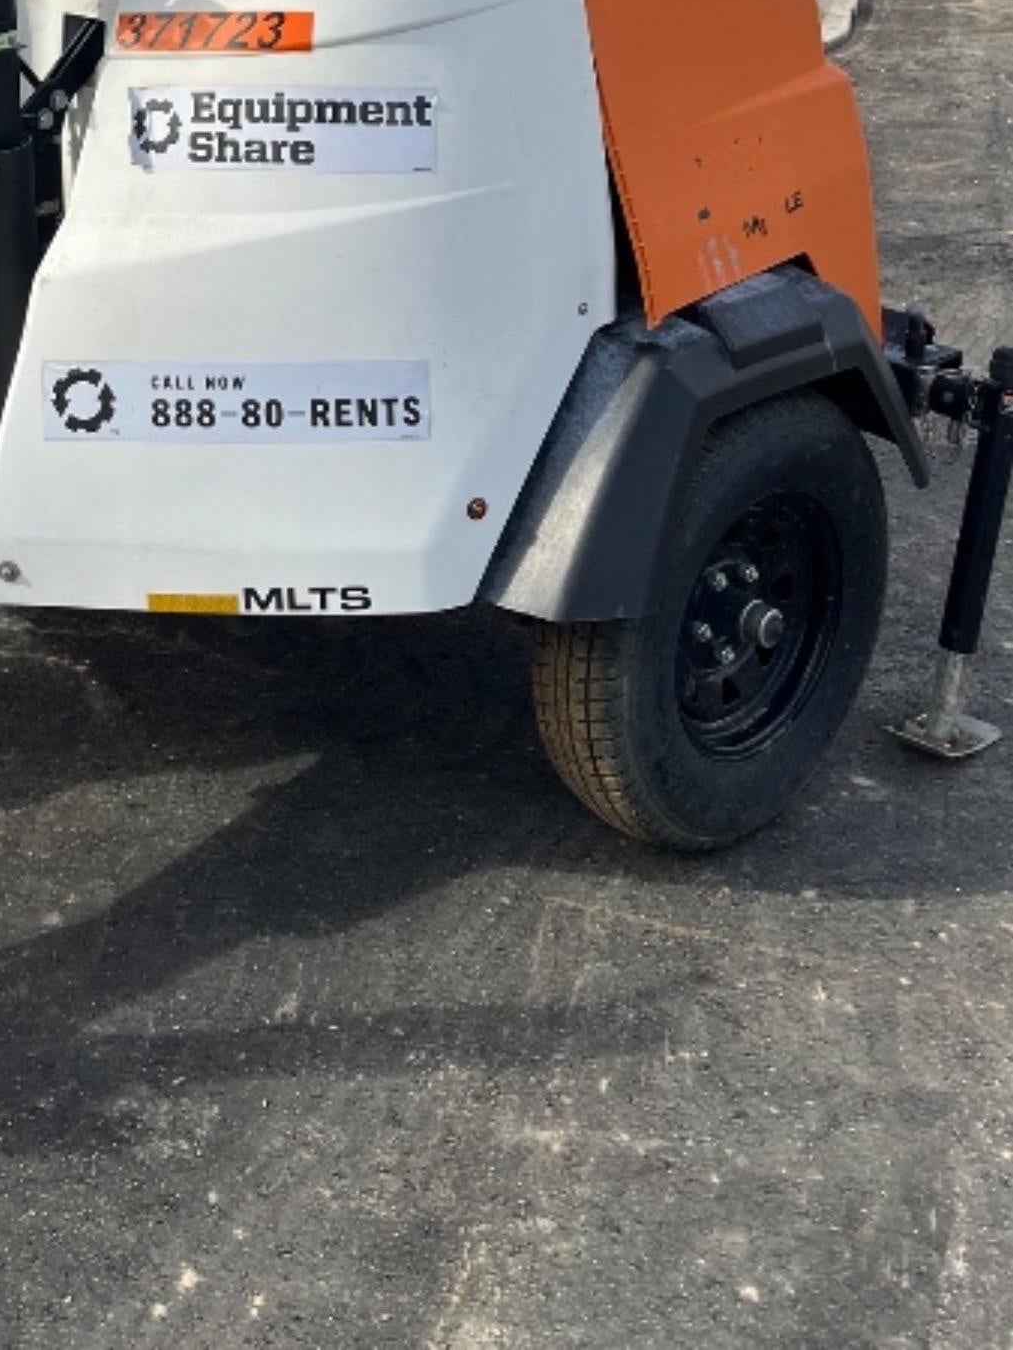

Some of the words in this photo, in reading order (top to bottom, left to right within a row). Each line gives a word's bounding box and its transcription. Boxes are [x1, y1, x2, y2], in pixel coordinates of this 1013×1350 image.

[118, 11, 285, 49] 371723
[190, 92, 433, 132] Equipment
[188, 132, 315, 164] Share
[150, 374, 196, 391] CALL
[205, 374, 246, 391] NOW
[150, 396, 421, 429] 888-80-RENTS
[242, 586, 373, 612] MLTS
